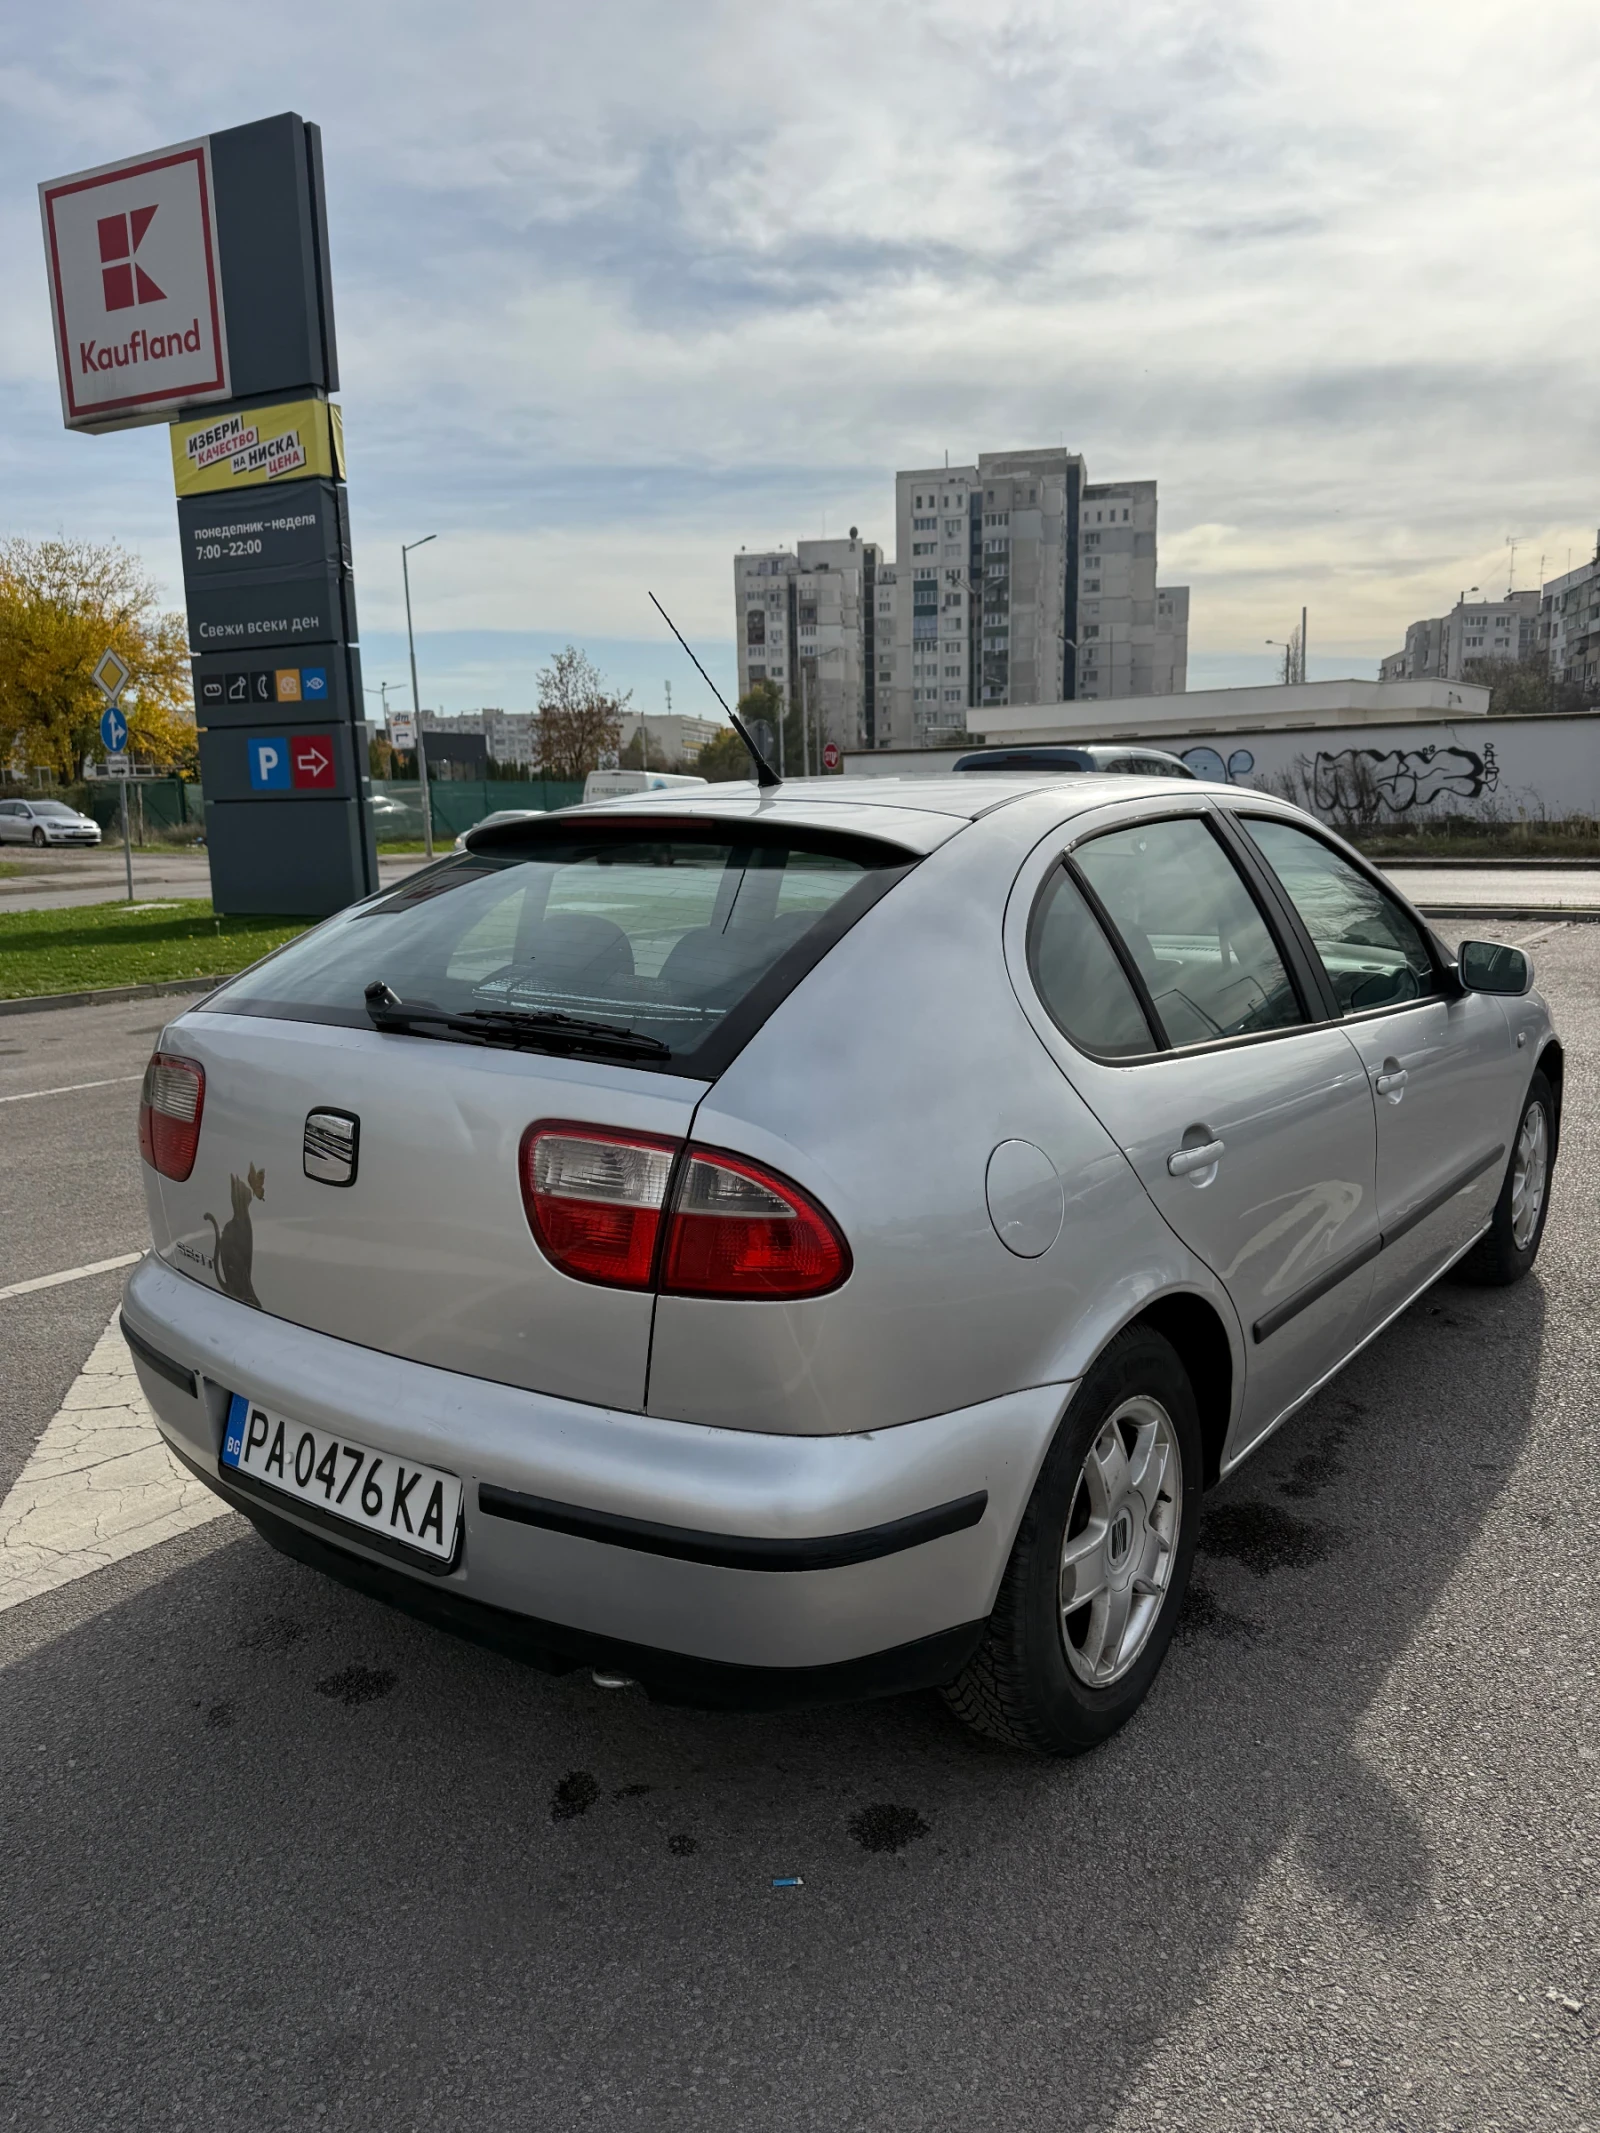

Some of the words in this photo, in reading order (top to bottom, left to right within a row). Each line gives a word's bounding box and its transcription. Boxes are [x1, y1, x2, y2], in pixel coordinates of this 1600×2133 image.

[80, 318, 201, 374] Kaufland
[188, 418, 240, 453] ИЗБЕРИ
[198, 430, 254, 464] КАЧЕСТВО
[233, 456, 246, 469] НА
[248, 434, 295, 466] НИСКА
[268, 450, 300, 473] ЦЕНА
[199, 622, 244, 638] Свежи
[247, 619, 288, 634] всеки
[291, 616, 319, 633] ден
[394, 712, 409, 722] dm
[258, 746, 278, 780] P
[226, 1436, 241, 1456] BG
